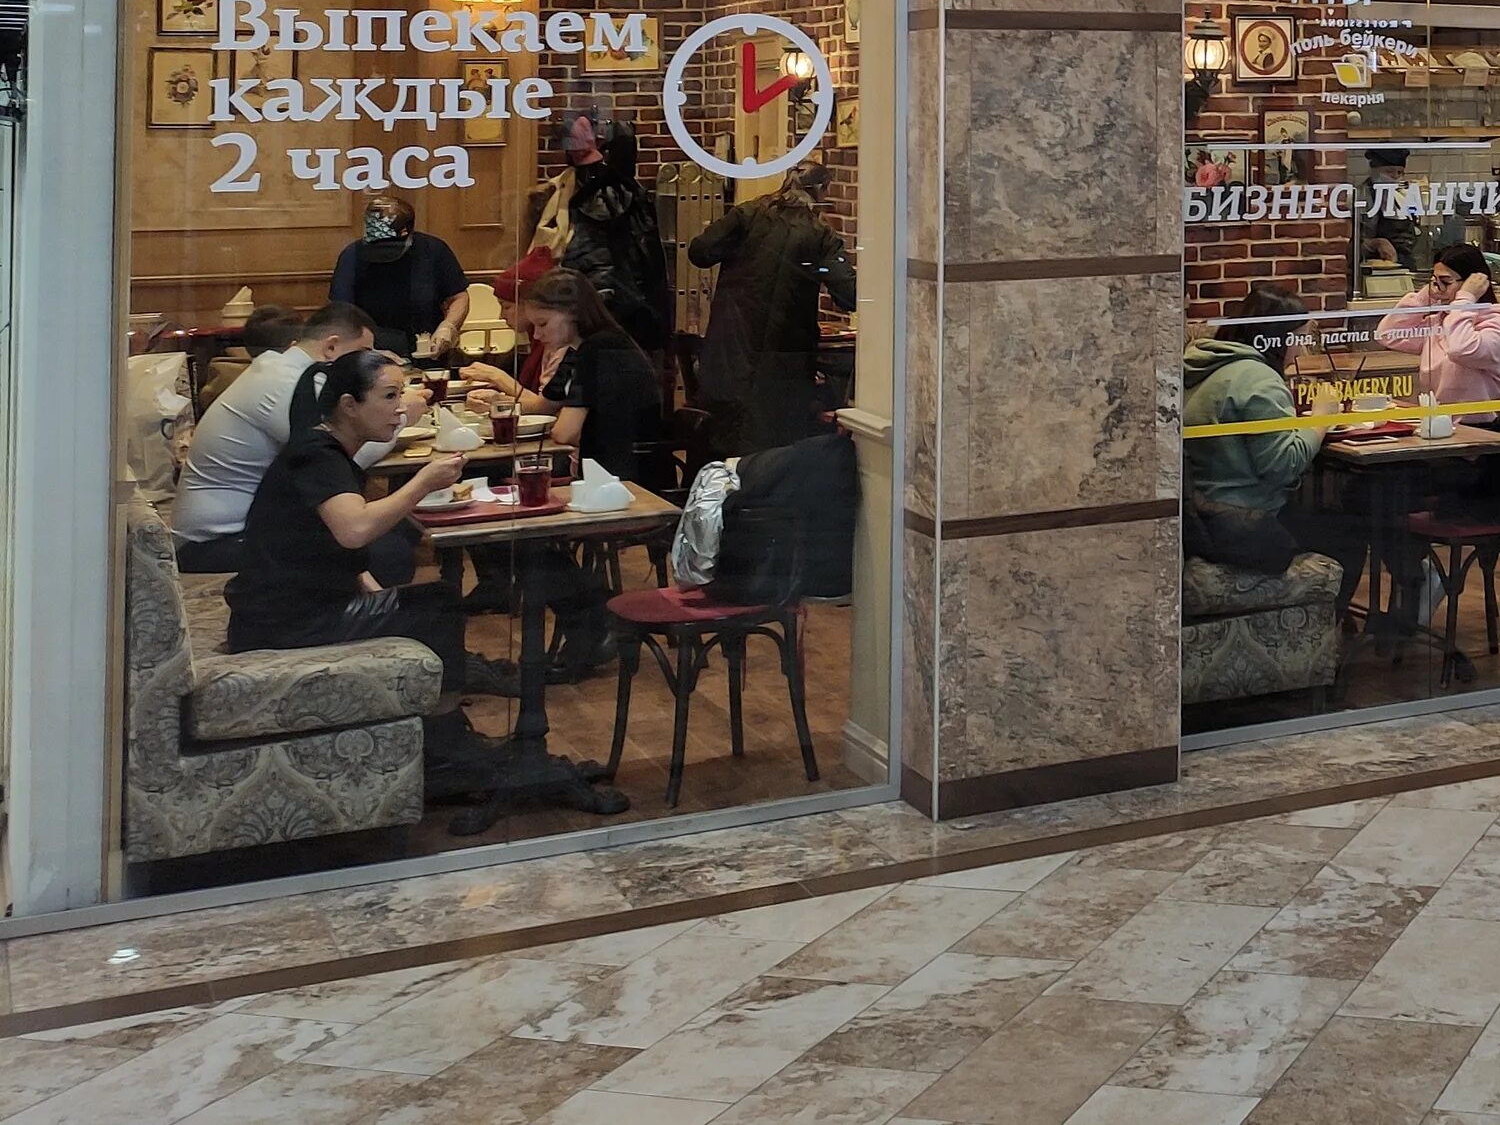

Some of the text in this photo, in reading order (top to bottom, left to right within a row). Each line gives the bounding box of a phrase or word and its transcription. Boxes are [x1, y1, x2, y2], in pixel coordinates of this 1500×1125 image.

[1289, 29, 1418, 59] поль бейкери
[208, 75, 554, 132] каждые
[1321, 92, 1384, 107] пекарня
[210, 133, 475, 193] 2 часа
[1253, 333, 1281, 352] Суп
[1286, 331, 1317, 347] дня,
[1321, 329, 1370, 347] паста
